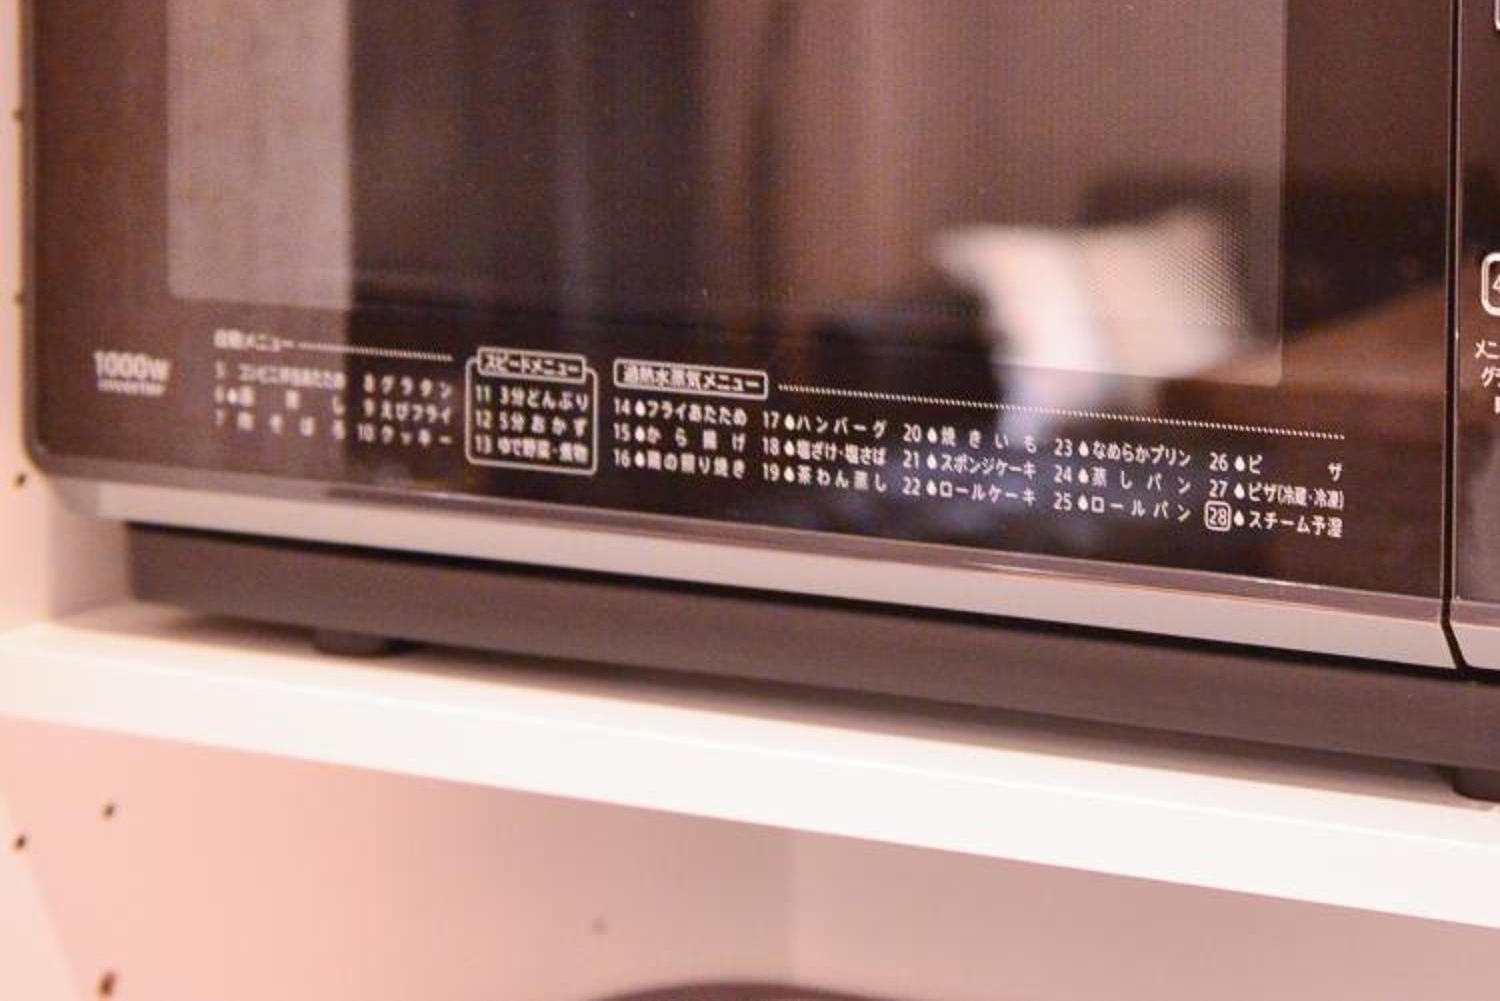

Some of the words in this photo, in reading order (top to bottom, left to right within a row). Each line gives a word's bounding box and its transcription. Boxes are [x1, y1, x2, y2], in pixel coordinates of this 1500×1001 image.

[484, 353, 580, 377] スピードメニュー
[613, 397, 632, 417] 14
[613, 422, 632, 442] 15
[762, 410, 780, 430] 17
[796, 414, 888, 440] ハンバーグ
[762, 436, 781, 456] 18
[903, 423, 922, 444] 20
[941, 425, 1037, 455] 焼きいも
[613, 448, 632, 468] 16
[1053, 437, 1073, 458] 23
[1092, 439, 1192, 467] なめらかプリン
[1209, 452, 1230, 472] 26
[762, 462, 781, 482] 19
[902, 448, 920, 469] 21
[941, 452, 1037, 480] スポンジケーキ
[1053, 463, 1073, 483] 24
[902, 476, 921, 496] 22
[939, 479, 1037, 506] ロールケーキ
[1208, 478, 1229, 498] 27
[1053, 490, 1073, 511] 25
[1091, 495, 1192, 522] ロールパン
[1209, 506, 1228, 526] 28
